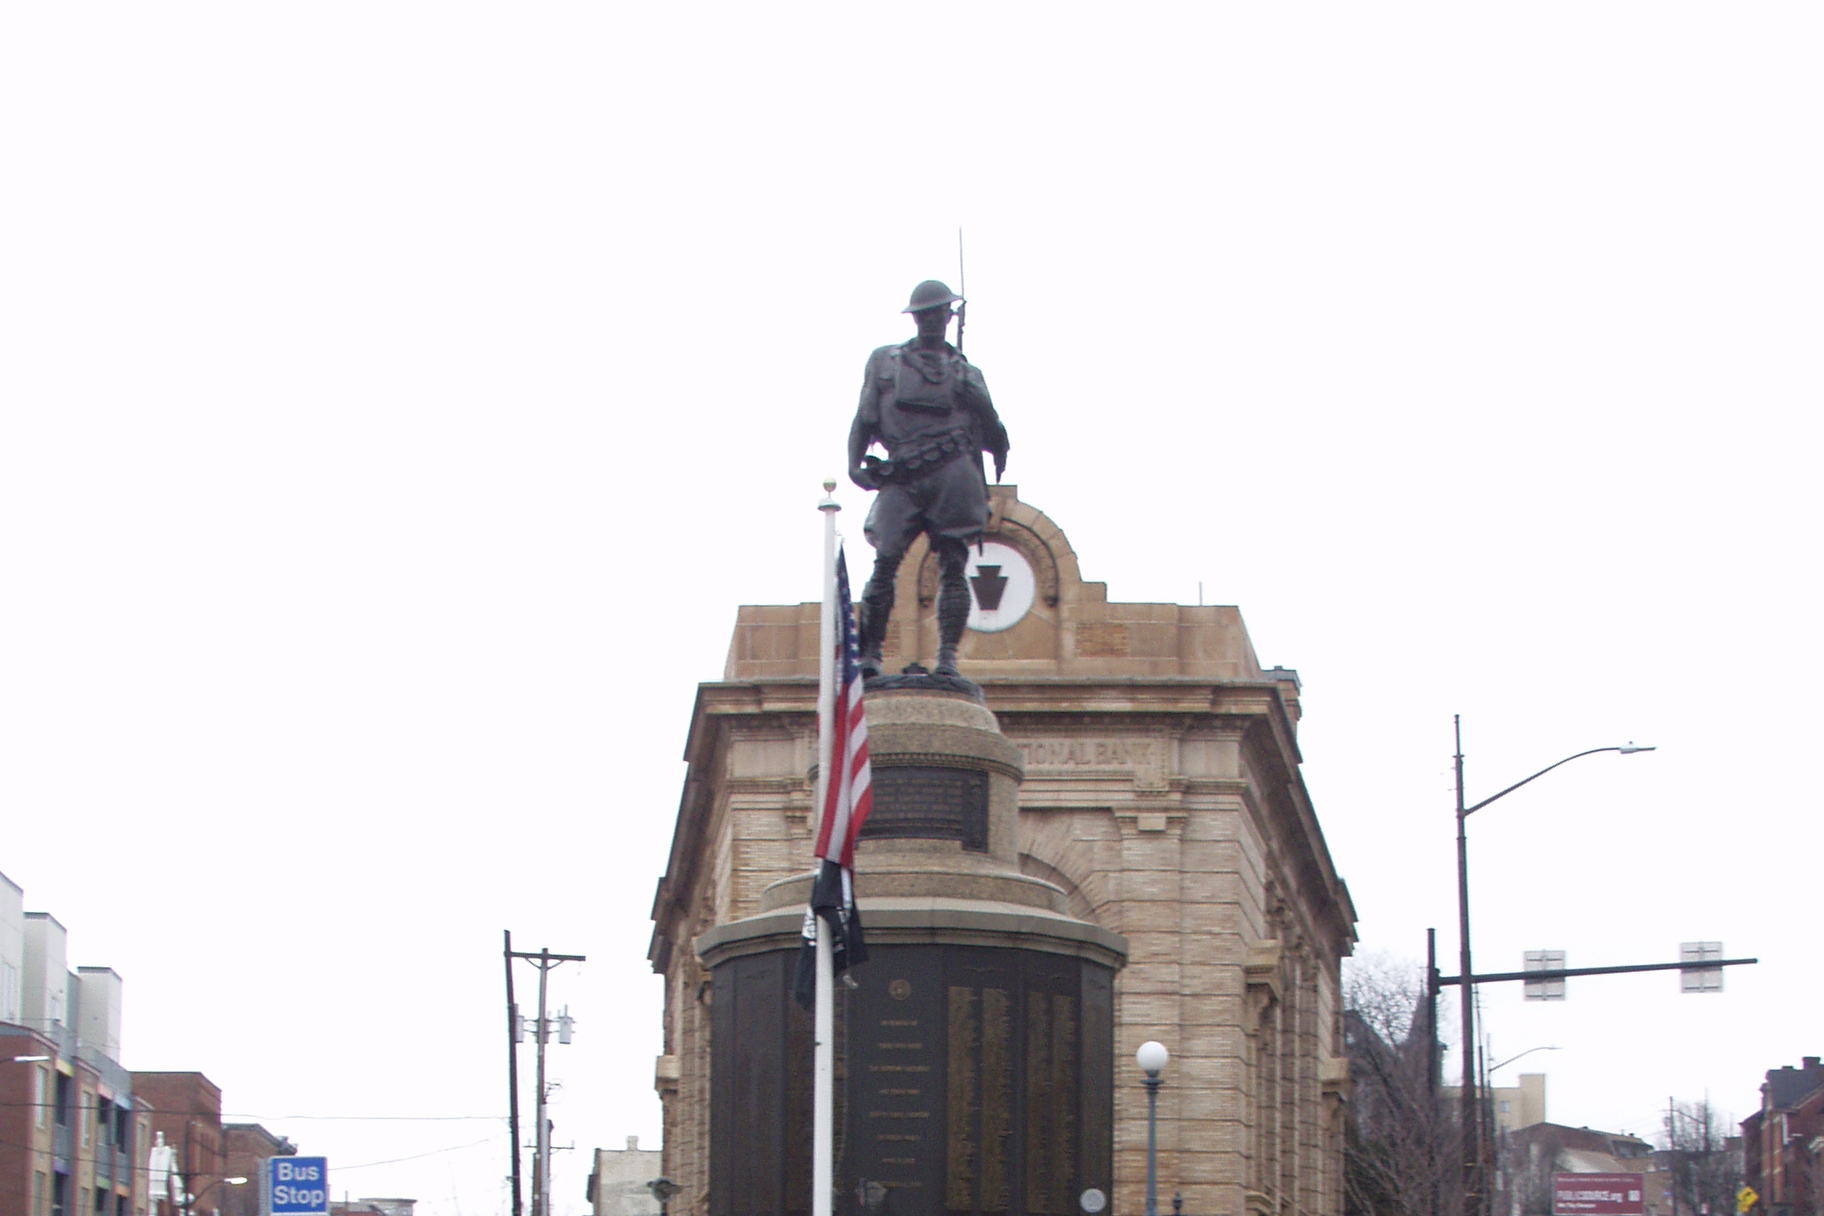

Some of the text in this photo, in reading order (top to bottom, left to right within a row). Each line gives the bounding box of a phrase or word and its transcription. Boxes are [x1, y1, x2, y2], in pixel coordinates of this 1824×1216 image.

[1016, 743, 1091, 765] TIONAL
[278, 1162, 320, 1181] Bus
[274, 1185, 325, 1208] Stop
